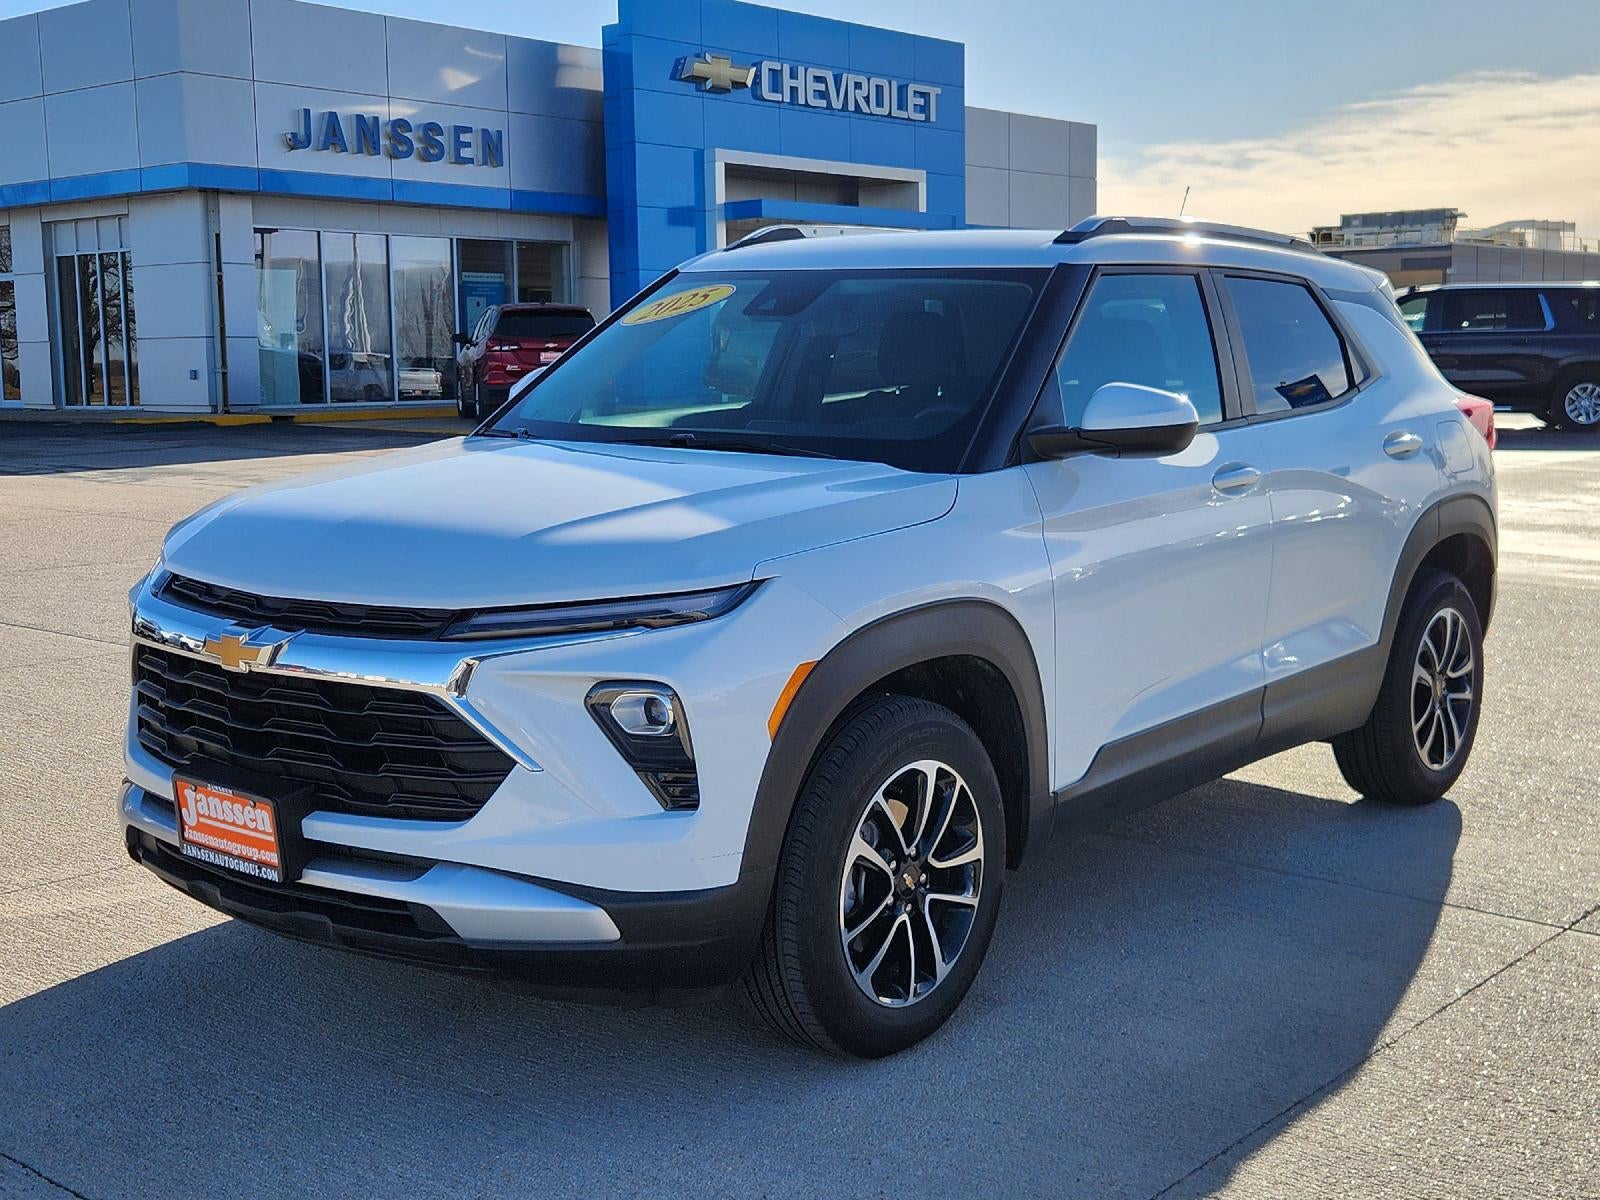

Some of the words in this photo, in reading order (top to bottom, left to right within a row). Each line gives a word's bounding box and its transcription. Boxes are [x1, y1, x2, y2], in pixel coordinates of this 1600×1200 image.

[760, 60, 942, 122] CHEVROLET
[283, 107, 504, 168] JANSSEN
[634, 288, 720, 321] 2025
[182, 787, 273, 832] Janssen
[182, 844, 279, 882] JANSSENAUTOGROUP.COM
[184, 826, 279, 862] Janssenautogroup.com
